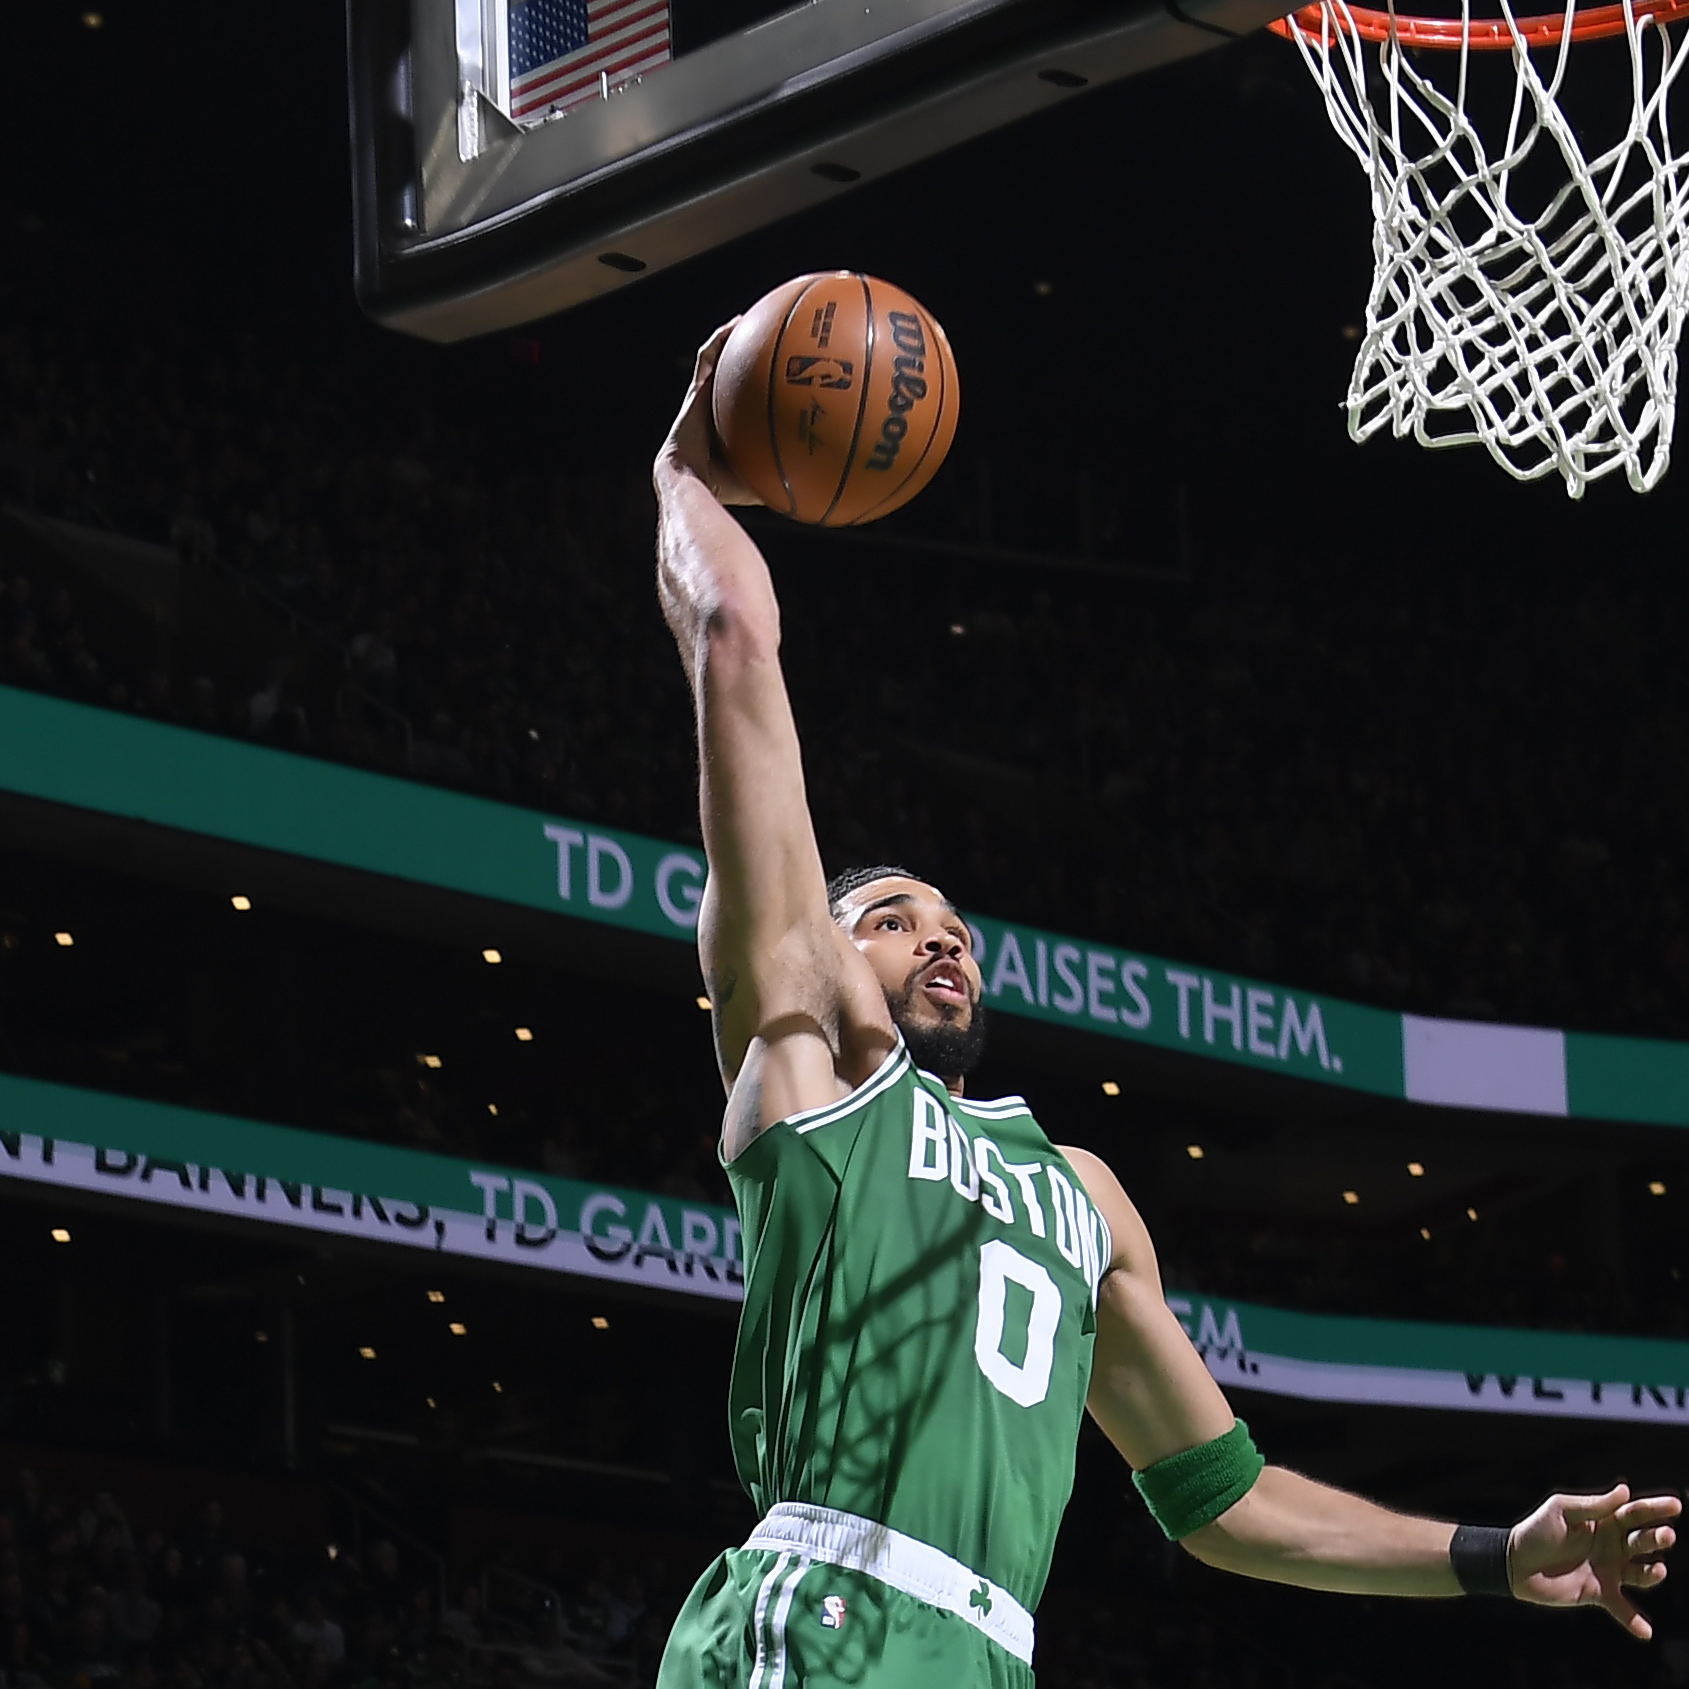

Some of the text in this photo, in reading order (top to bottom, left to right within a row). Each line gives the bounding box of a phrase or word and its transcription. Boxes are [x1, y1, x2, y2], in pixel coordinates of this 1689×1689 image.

[866, 310, 929, 471] Wilson
[543, 822, 634, 909] TD
[1164, 967, 1344, 1073] THEM.
[469, 1170, 558, 1248] TD
[908, 1086, 1099, 1288] BOSTON
[975, 1238, 1062, 1408] 0
